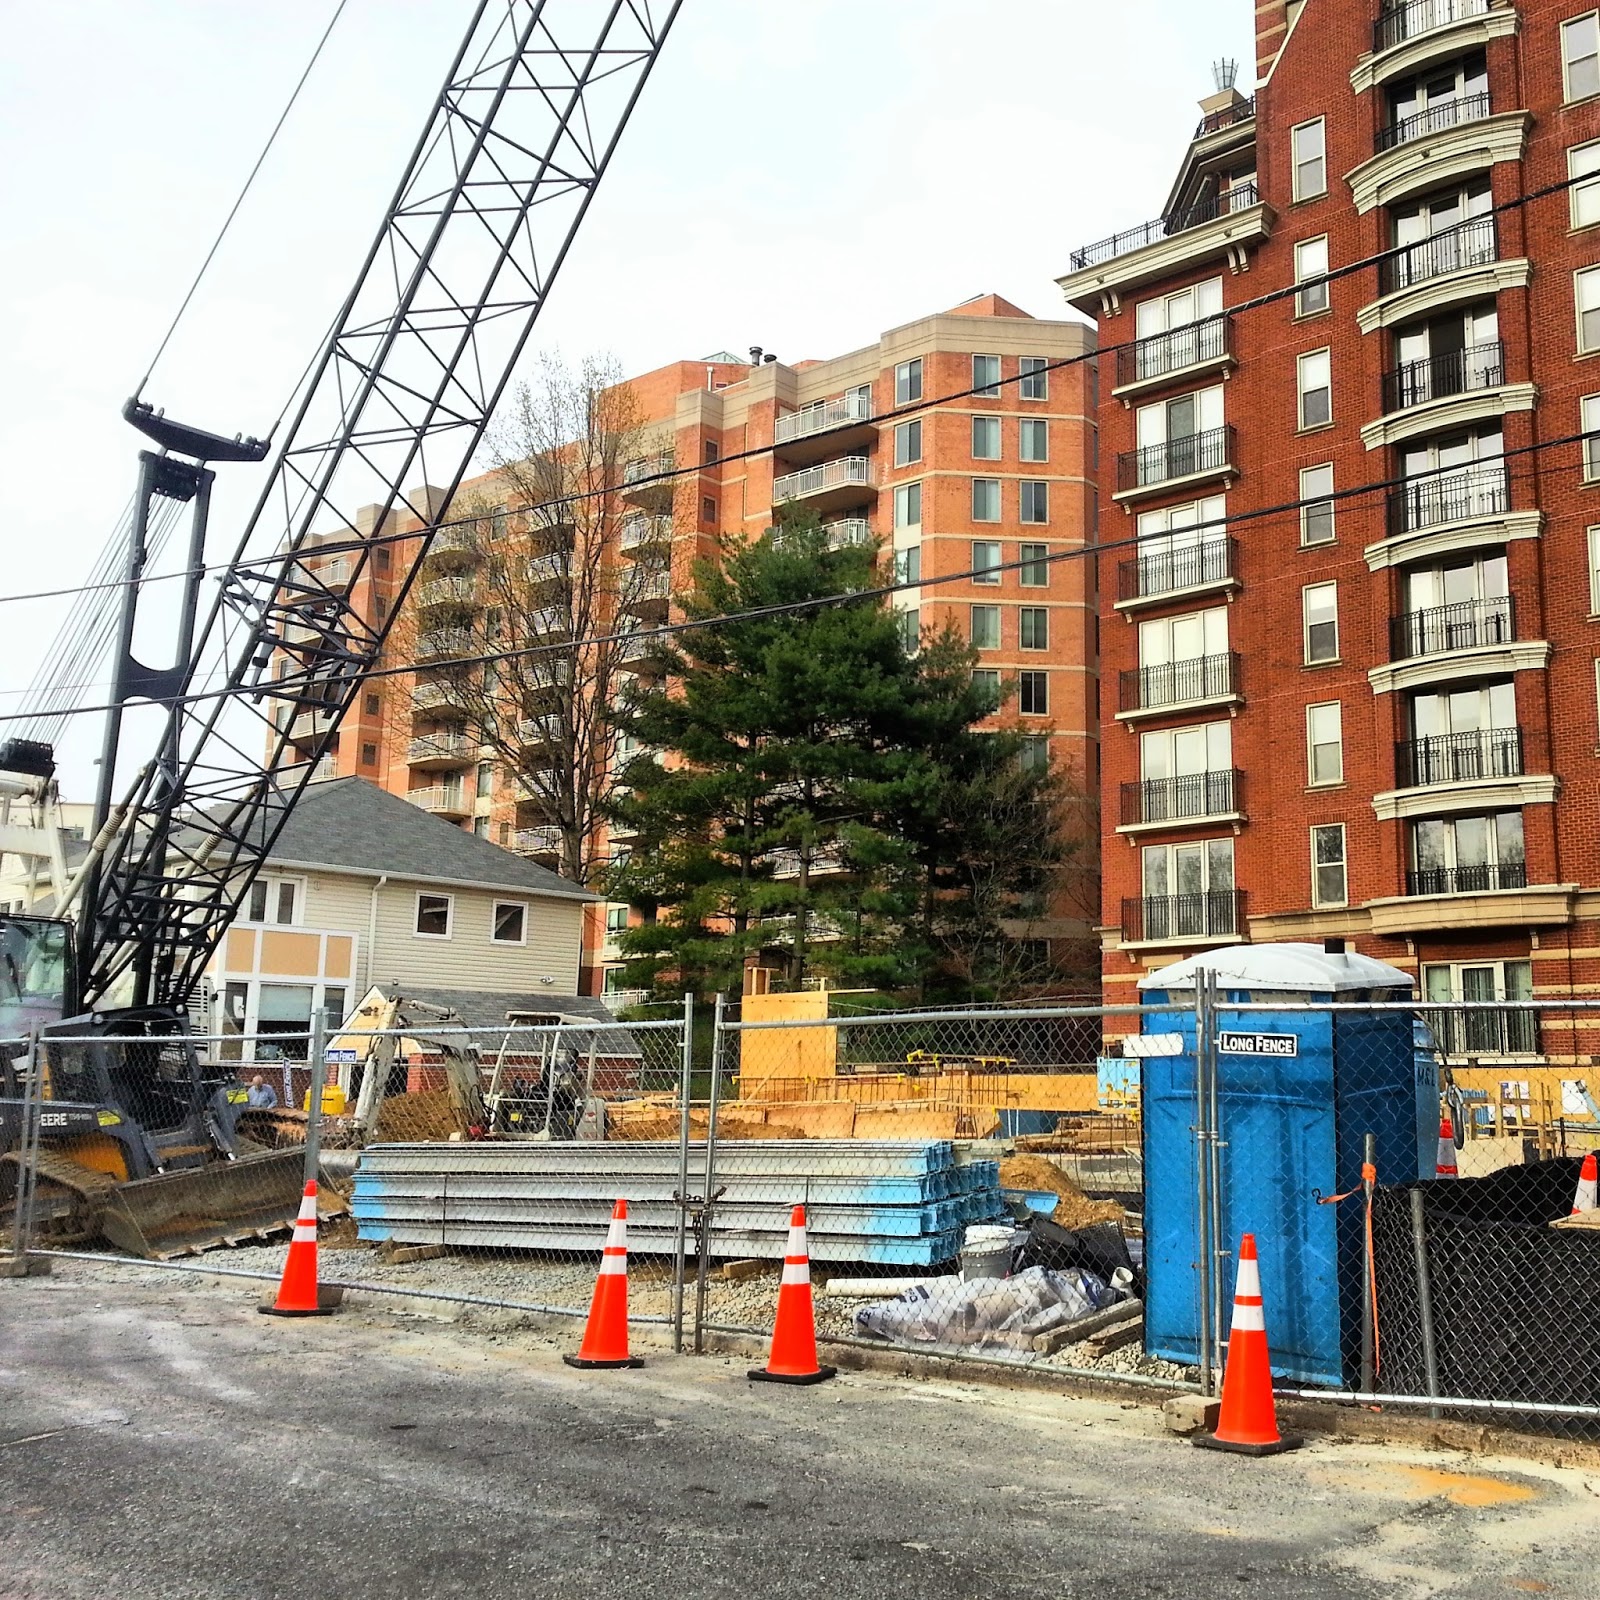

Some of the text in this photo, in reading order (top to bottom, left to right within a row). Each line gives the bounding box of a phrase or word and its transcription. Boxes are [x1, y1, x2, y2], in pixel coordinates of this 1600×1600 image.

[1223, 1034, 1293, 1053] LONG FENCE
[326, 1050, 355, 1062] LONG FENCE
[41, 1113, 67, 1126] EERE
